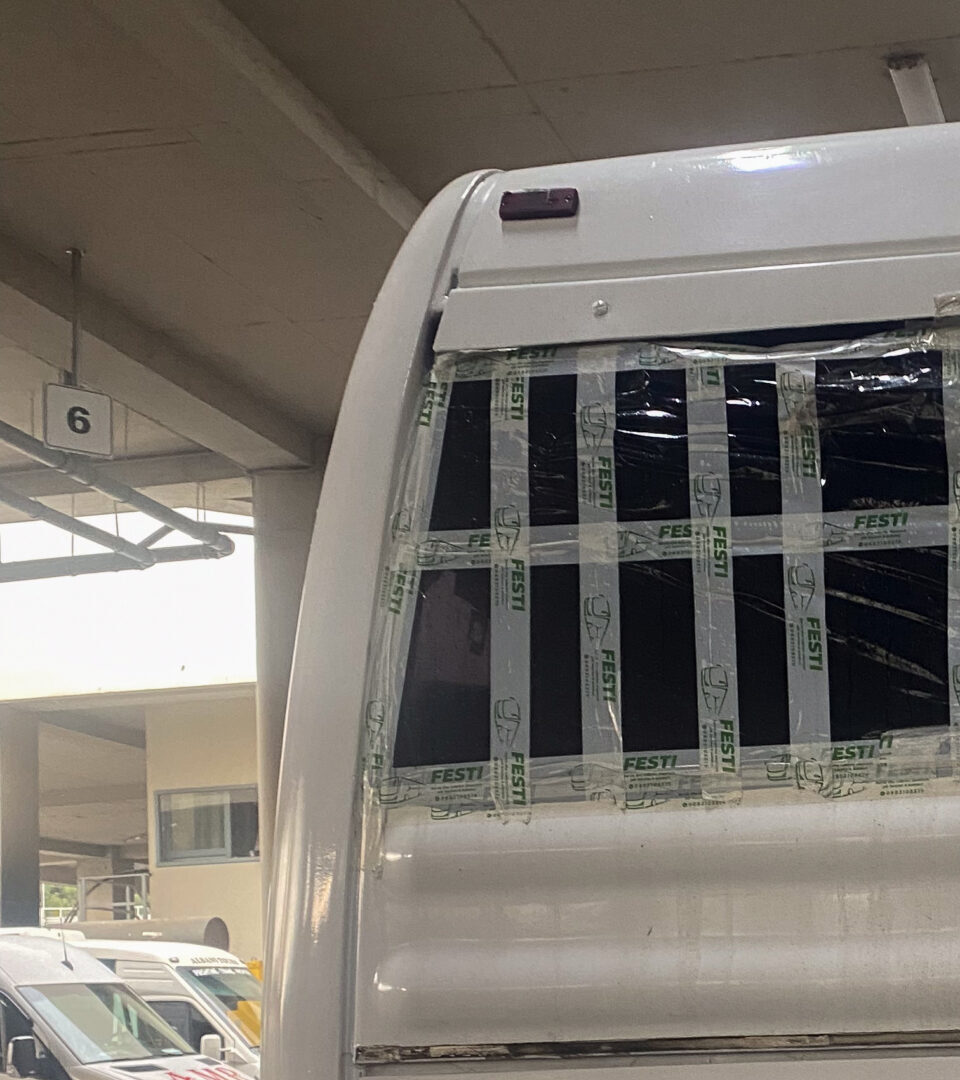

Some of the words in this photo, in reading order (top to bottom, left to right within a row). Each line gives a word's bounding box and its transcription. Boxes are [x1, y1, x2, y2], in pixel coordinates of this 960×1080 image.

[66, 406, 91, 434] 6
[801, 424, 818, 479] FESTI
[598, 456, 613, 508] FESTI
[659, 524, 692, 538] FES
[853, 512, 908, 529] FESTI
[713, 526, 728, 577] FESTI
[511, 558, 526, 611] FESTI
[807, 617, 823, 671] FESTI
[602, 649, 616, 702] FESTI
[623, 755, 677, 770] FESTI
[719, 719, 736, 773] FESTI
[831, 744, 875, 760] ESTI
[431, 766, 483, 784] FESTI
[511, 751, 526, 805] FESTI
